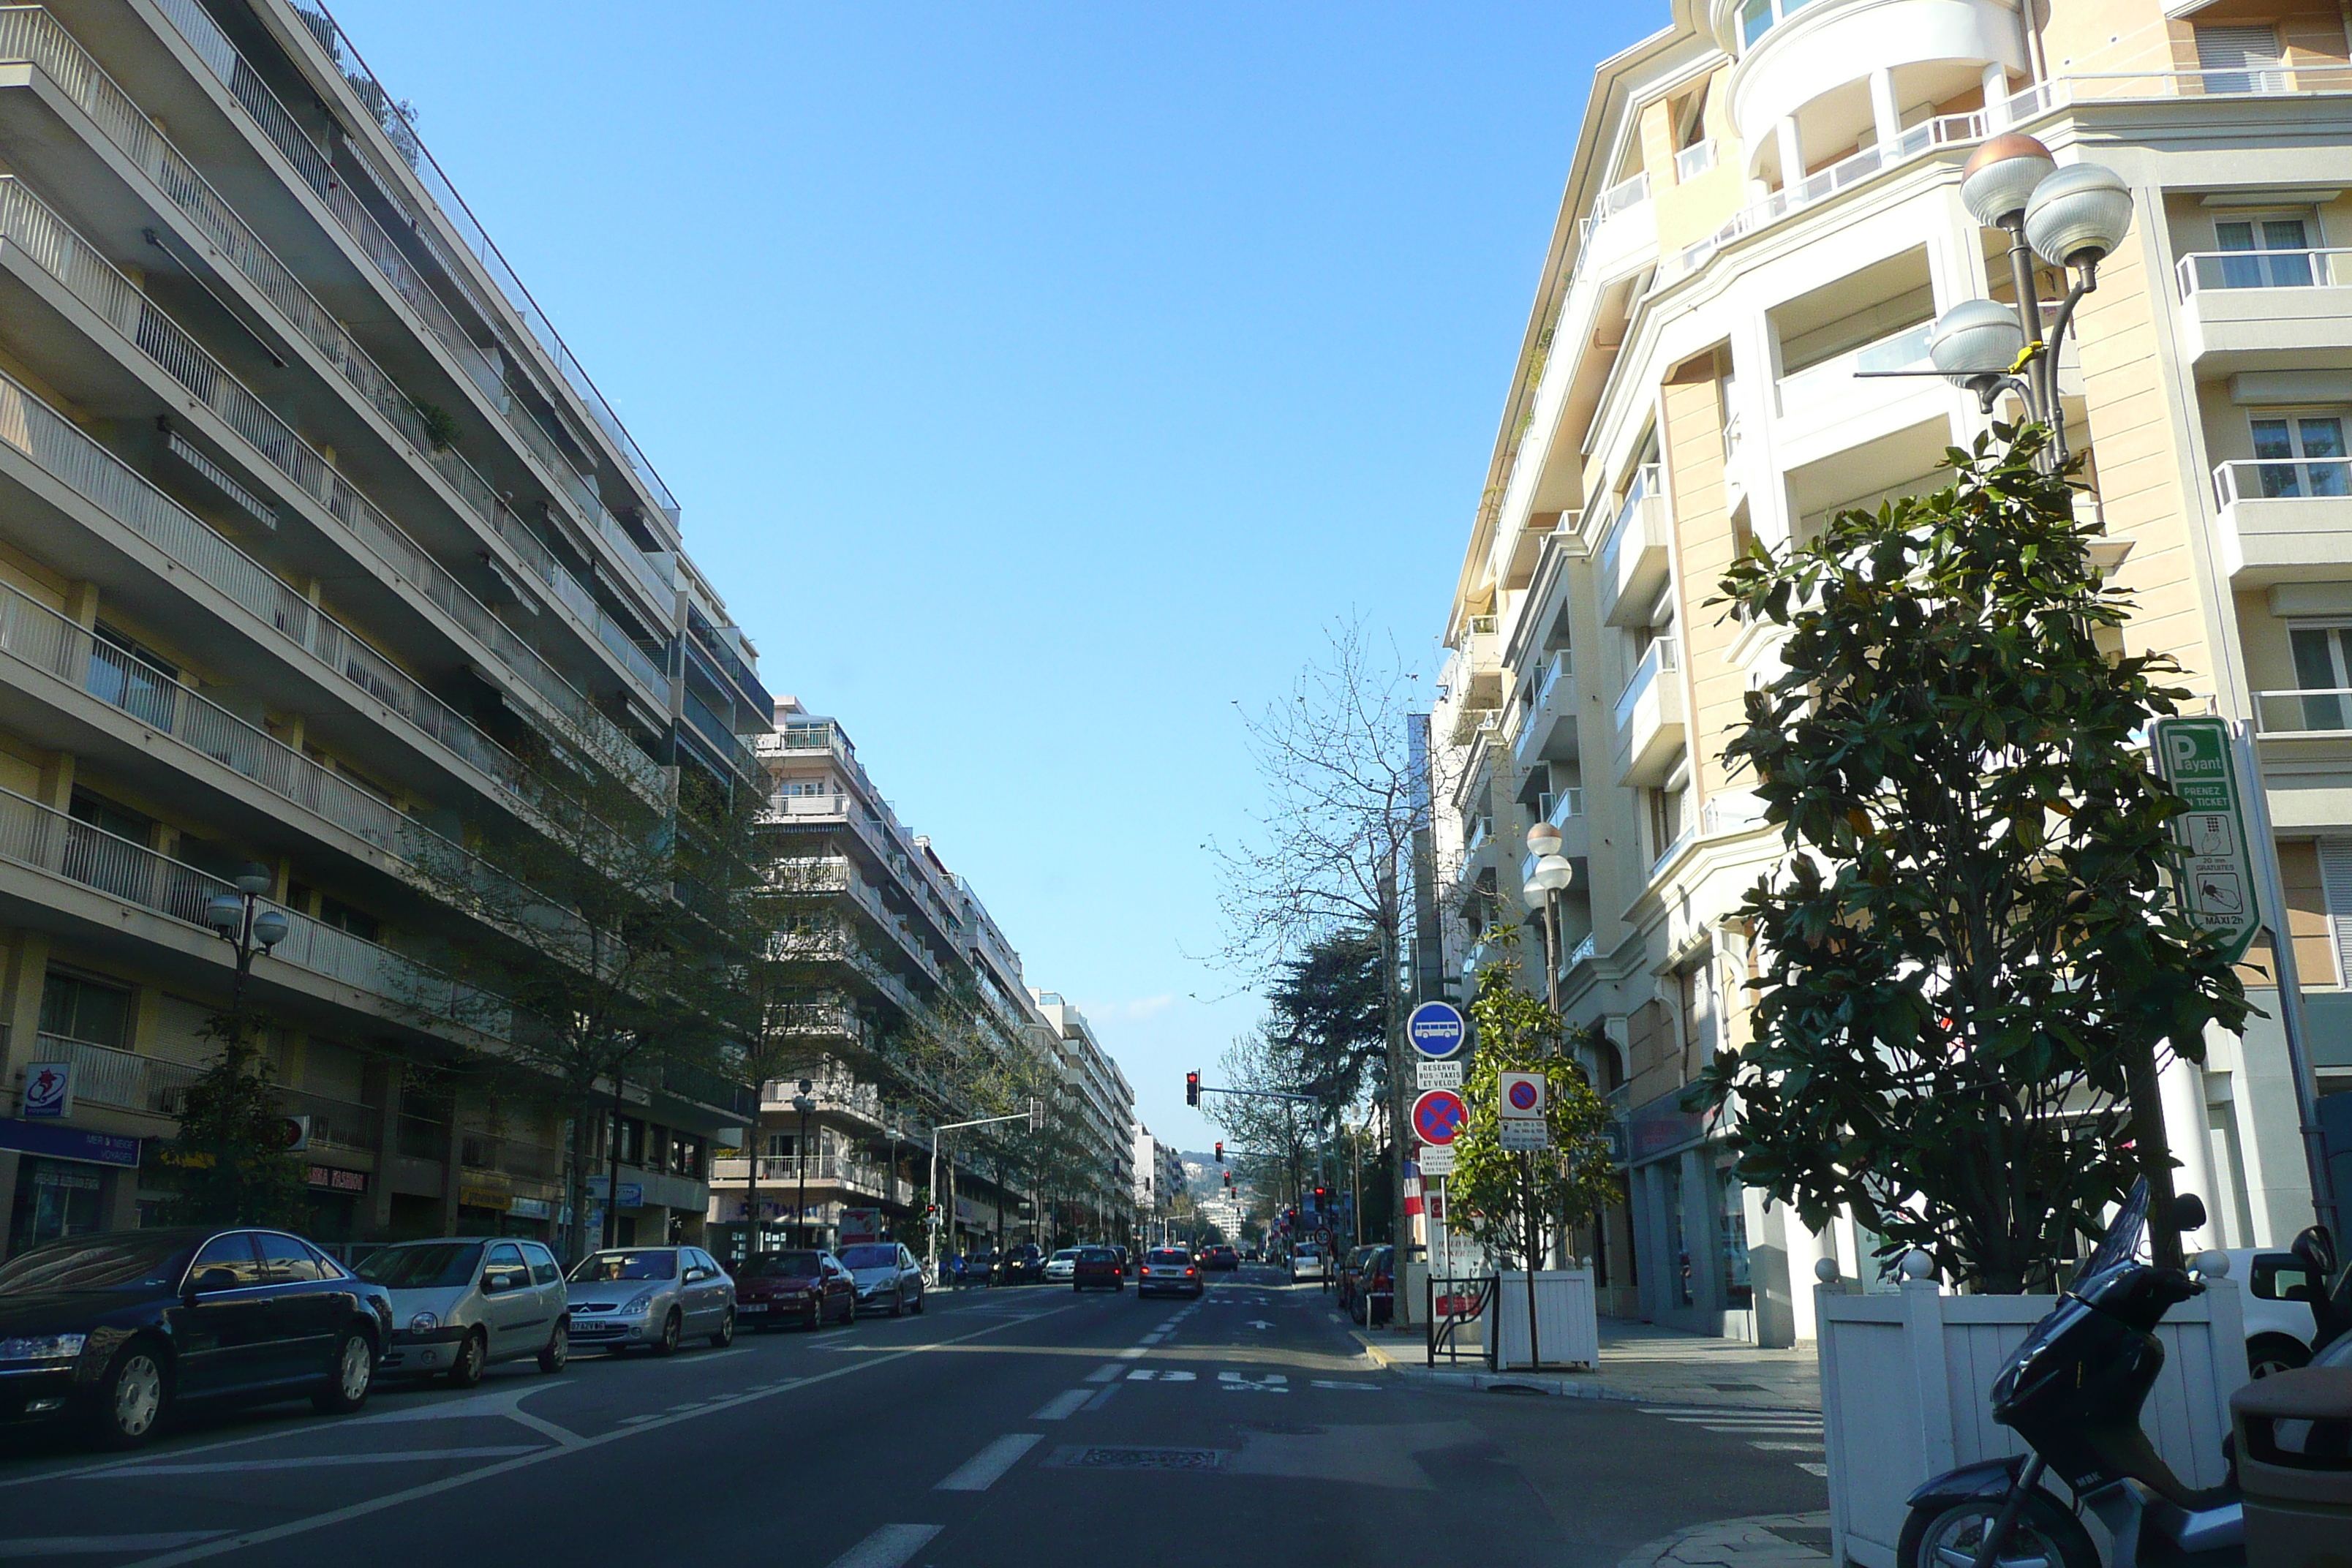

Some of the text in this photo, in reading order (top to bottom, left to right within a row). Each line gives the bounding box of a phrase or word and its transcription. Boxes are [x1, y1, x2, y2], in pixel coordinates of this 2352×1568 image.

[2170, 734, 2222, 772] Payant
[2185, 787, 2221, 796] PRENEZ
[2197, 797, 2228, 806] TICKET
[2206, 916, 2244, 924] MAXI 2h
[2076, 1471, 2103, 1488] MBK
